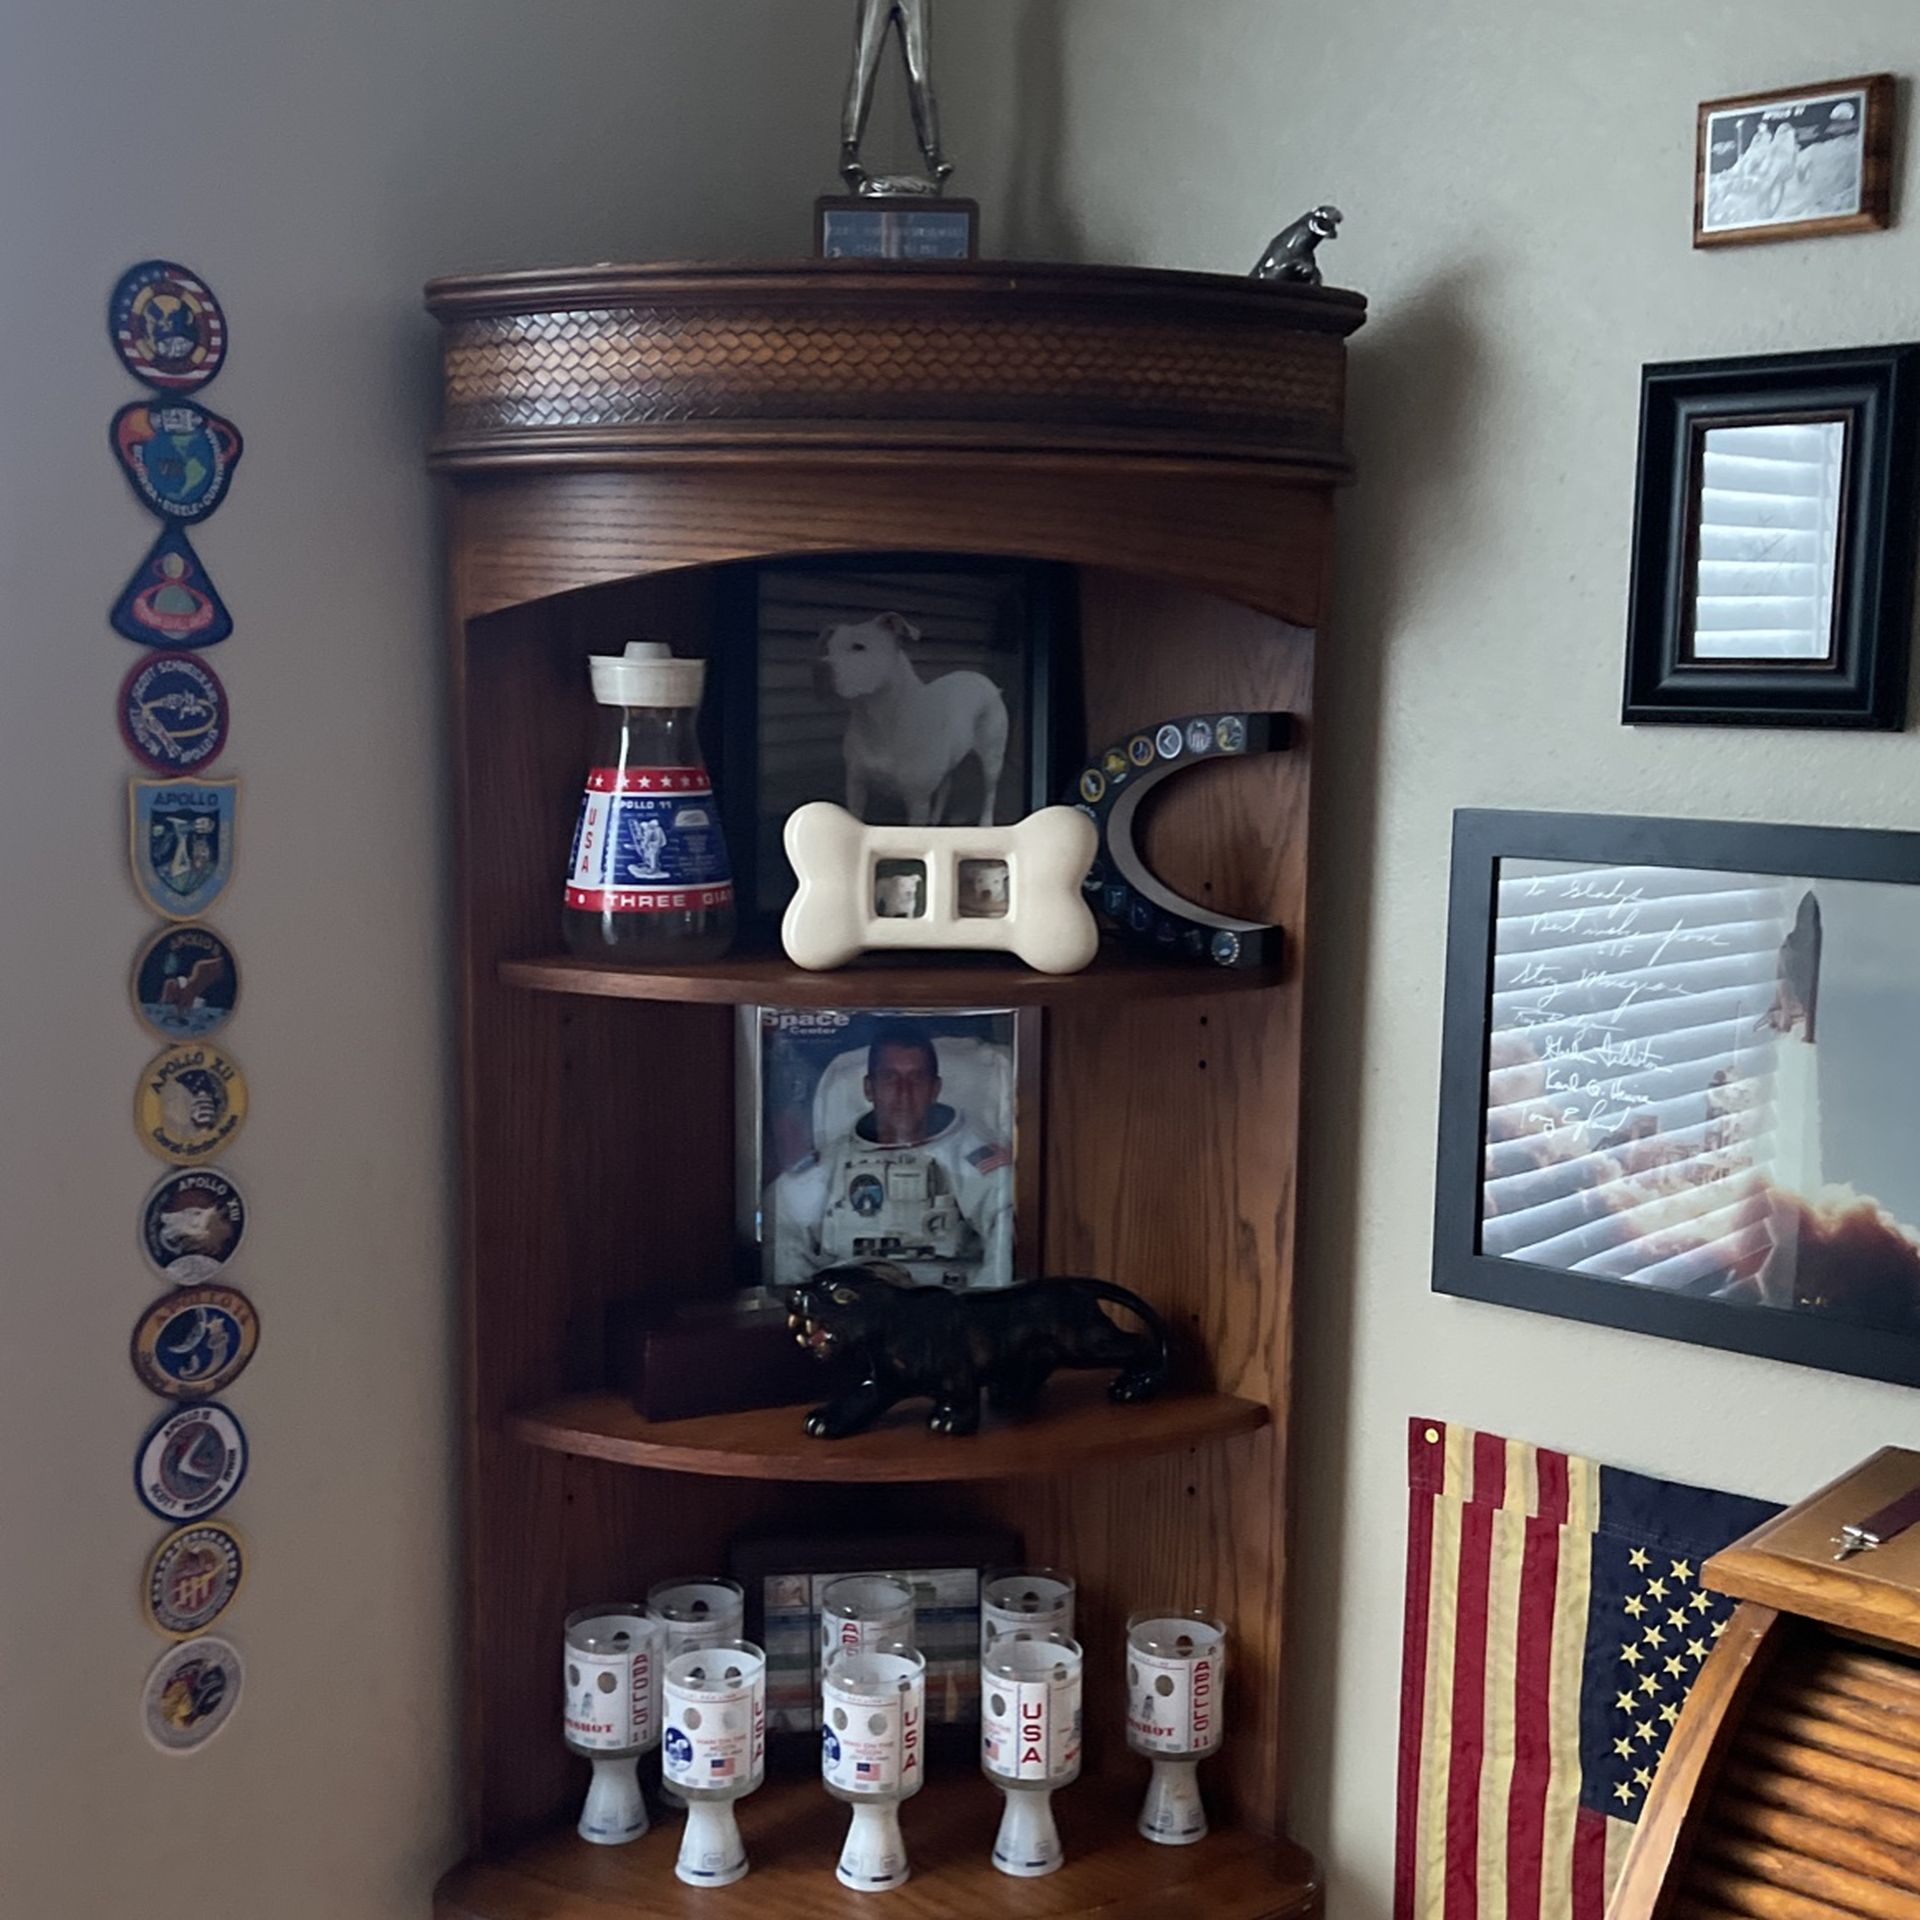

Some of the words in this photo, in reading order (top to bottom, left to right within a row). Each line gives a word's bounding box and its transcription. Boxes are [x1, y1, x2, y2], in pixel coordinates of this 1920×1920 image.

[154, 791, 220, 806] APOLLO
[581, 808, 598, 872] USA
[604, 893, 686, 908] THREE
[762, 1008, 850, 1030] Space
[151, 1051, 205, 1094] APOLLO
[178, 1177, 228, 1196] APOLLO
[226, 1197, 241, 1223] XIII
[632, 1653, 649, 1726] APOLLO
[1193, 1661, 1210, 1731] APOLLO
[903, 1706, 919, 1773] USA
[1021, 1702, 1043, 1764] USA
